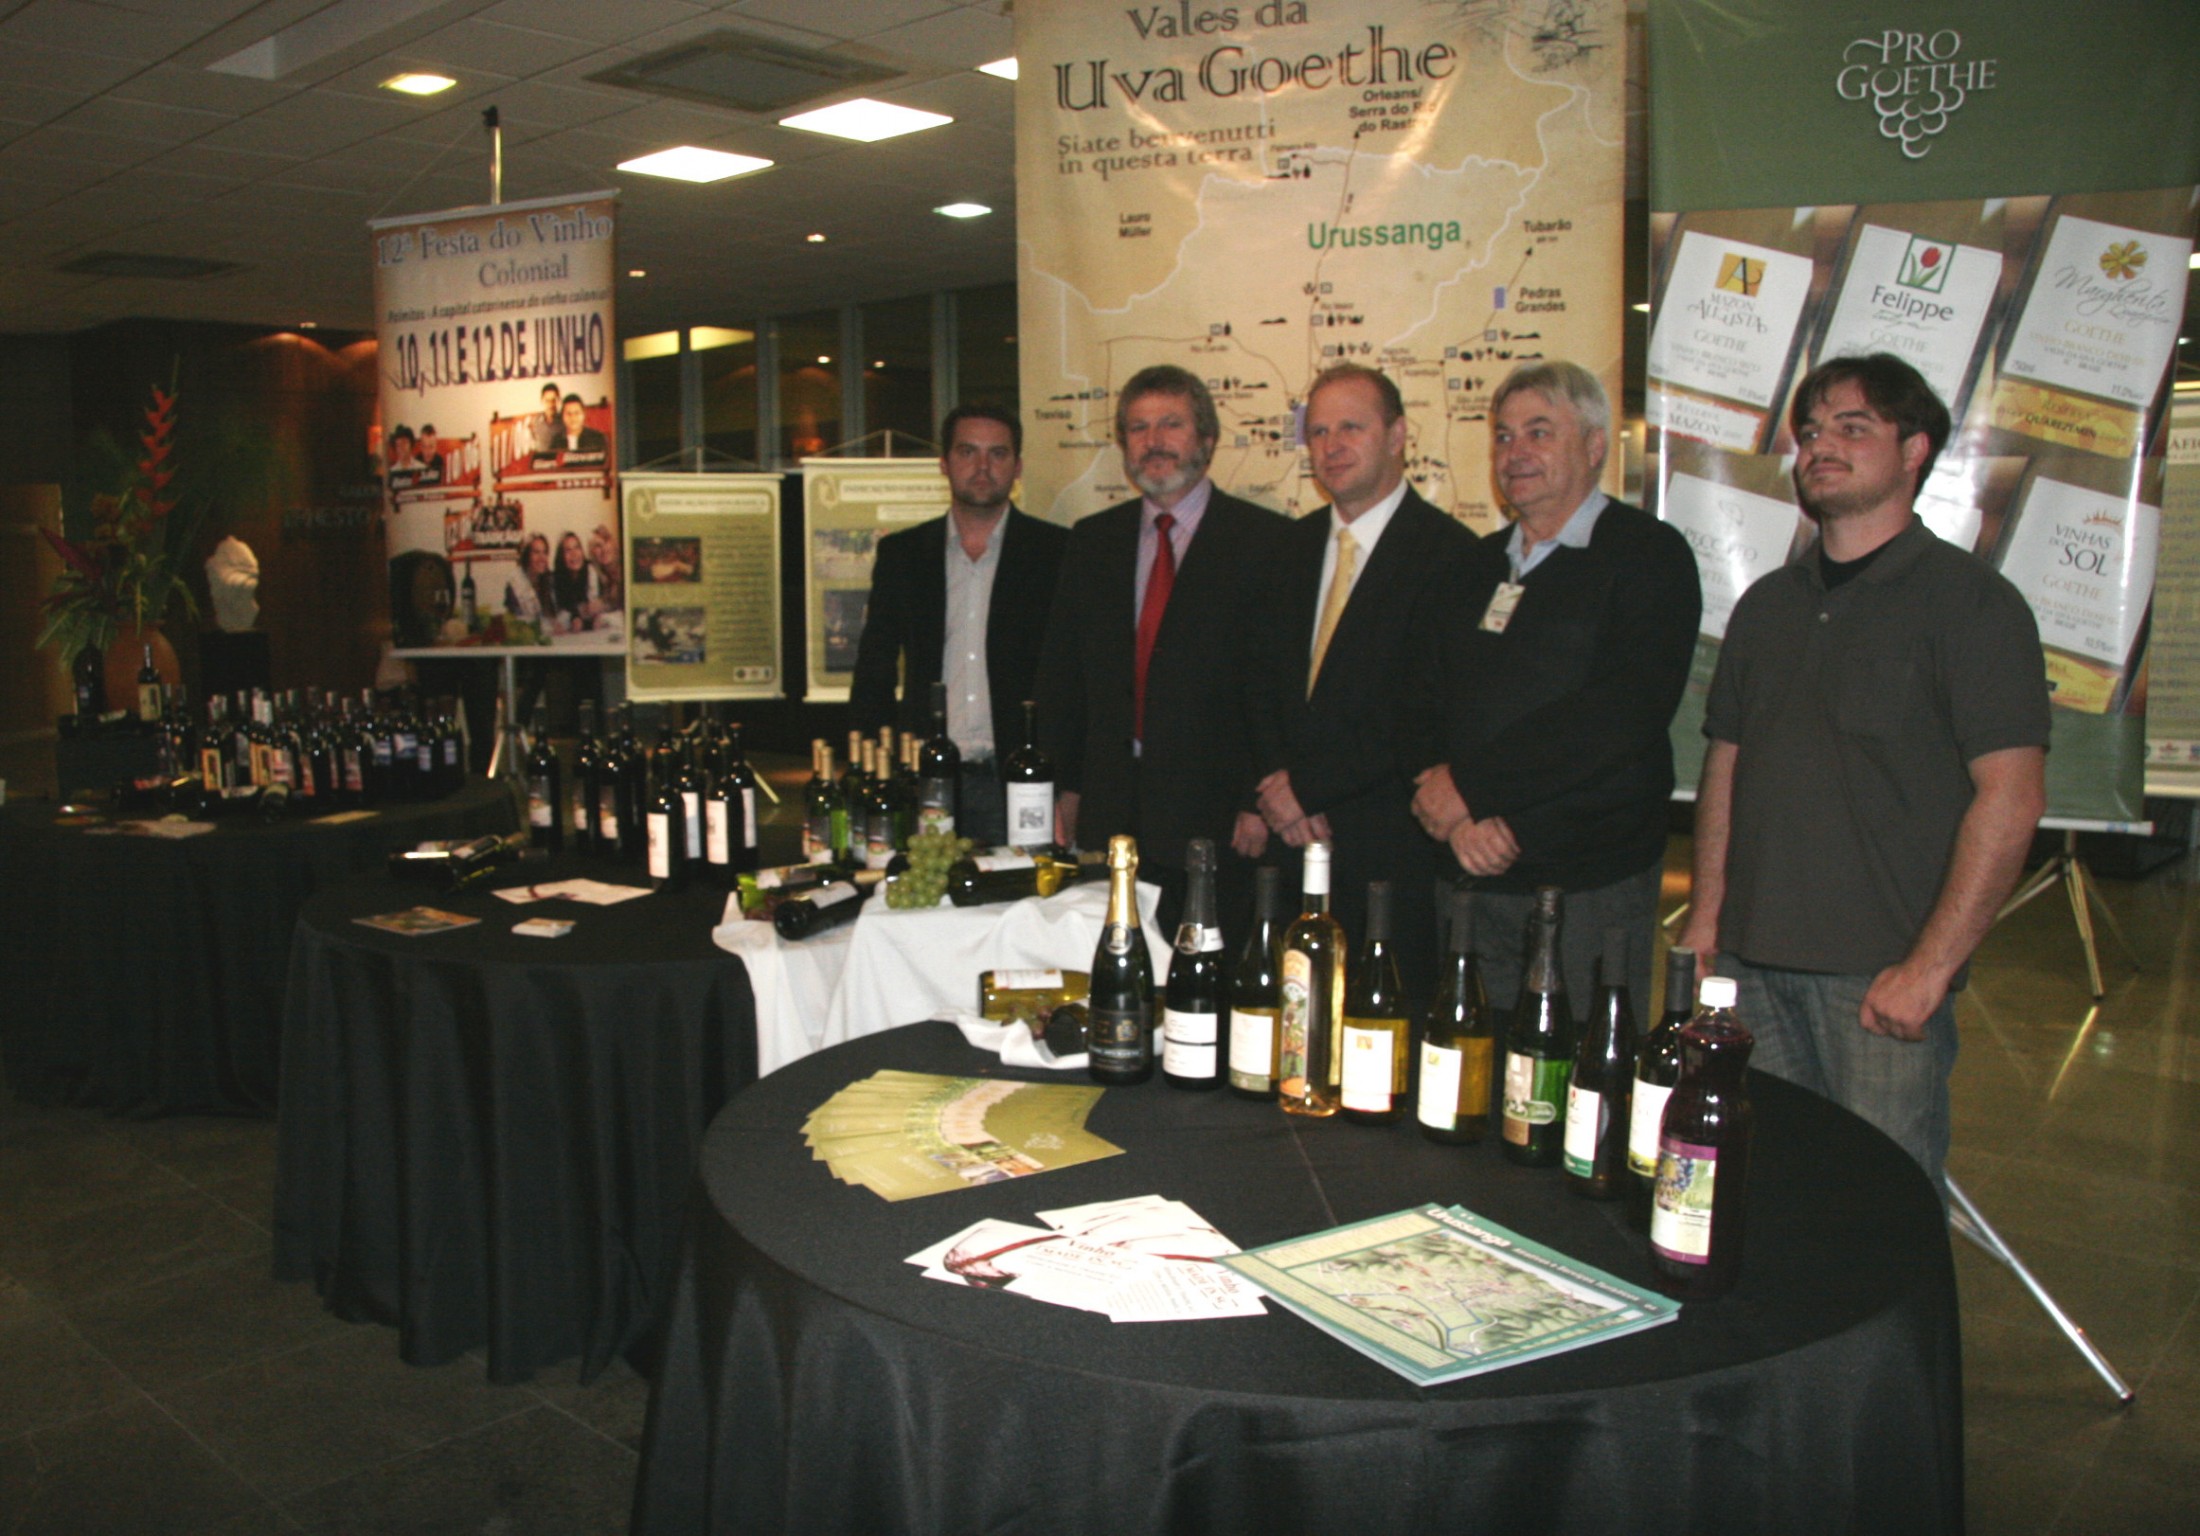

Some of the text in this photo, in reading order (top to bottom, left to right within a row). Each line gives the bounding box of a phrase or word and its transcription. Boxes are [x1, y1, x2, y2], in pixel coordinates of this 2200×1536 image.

[1127, 0, 1309, 39] Vales da
[1843, 29, 1961, 63] PRO
[1053, 26, 1457, 111] Uva Goethe
[1836, 60, 1997, 100] GOETHE
[1349, 105, 1387, 119] Serra
[1391, 102, 1409, 116] do
[1363, 87, 1423, 102] Orleans/
[1358, 120, 1377, 133] do
[1058, 135, 1121, 156] Siate
[1059, 156, 1083, 175] in
[1092, 150, 1177, 181] questa
[420, 227, 480, 261] Festa
[489, 219, 522, 250] do
[528, 208, 614, 244] Vinho
[1308, 220, 1461, 250] Urussanga
[478, 253, 569, 288] Colonial
[1515, 299, 1567, 315] Grandes
[1520, 286, 1562, 300] Pedras
[1871, 284, 1954, 321] Felippe
[501, 319, 527, 381] DE
[533, 311, 605, 378] JUNHO
[1668, 412, 1721, 437] MAZON
[2055, 523, 2111, 550] VINHAS
[2058, 542, 2108, 577] SOL
[1427, 1207, 1512, 1248] Urussanga
